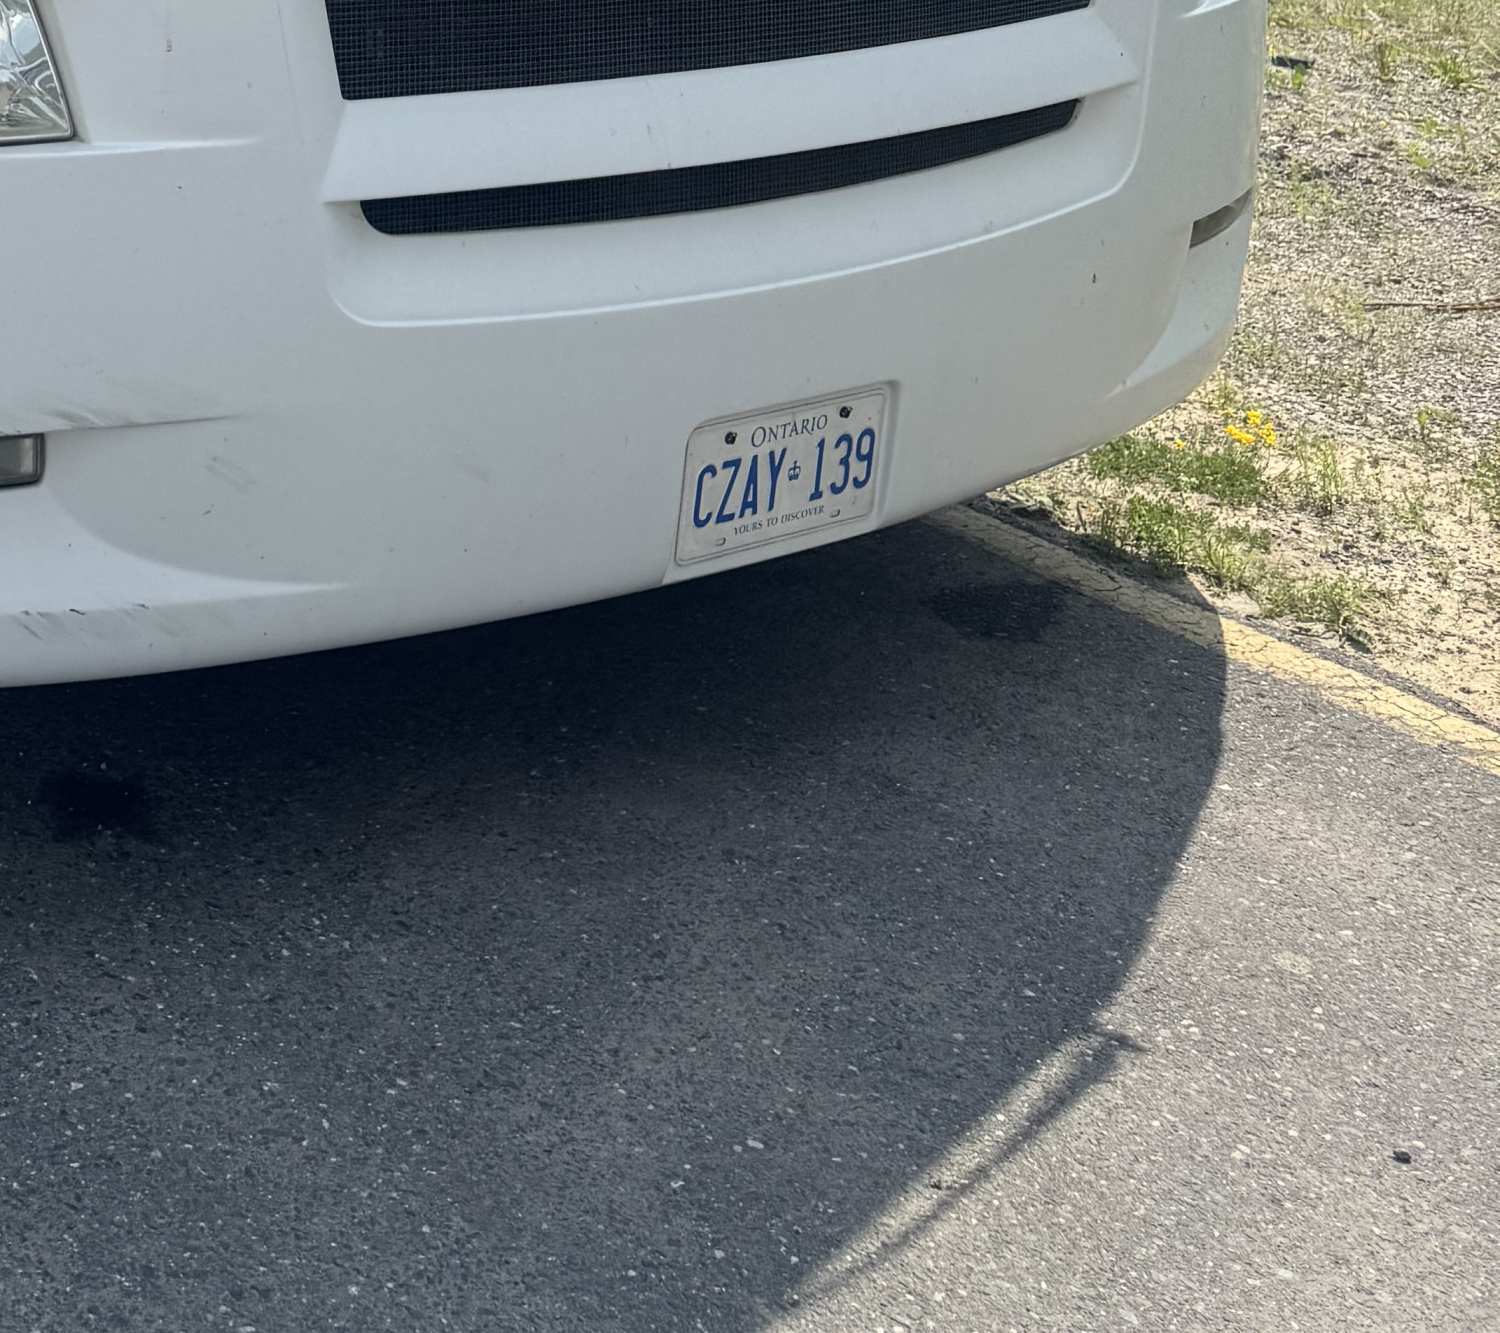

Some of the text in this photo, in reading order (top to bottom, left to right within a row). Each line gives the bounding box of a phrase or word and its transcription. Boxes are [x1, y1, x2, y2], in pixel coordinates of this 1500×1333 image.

[751, 414, 828, 448] ONTARIO
[692, 427, 876, 529] CZAY 139
[734, 505, 825, 536] YOURS TO DISCOVER
